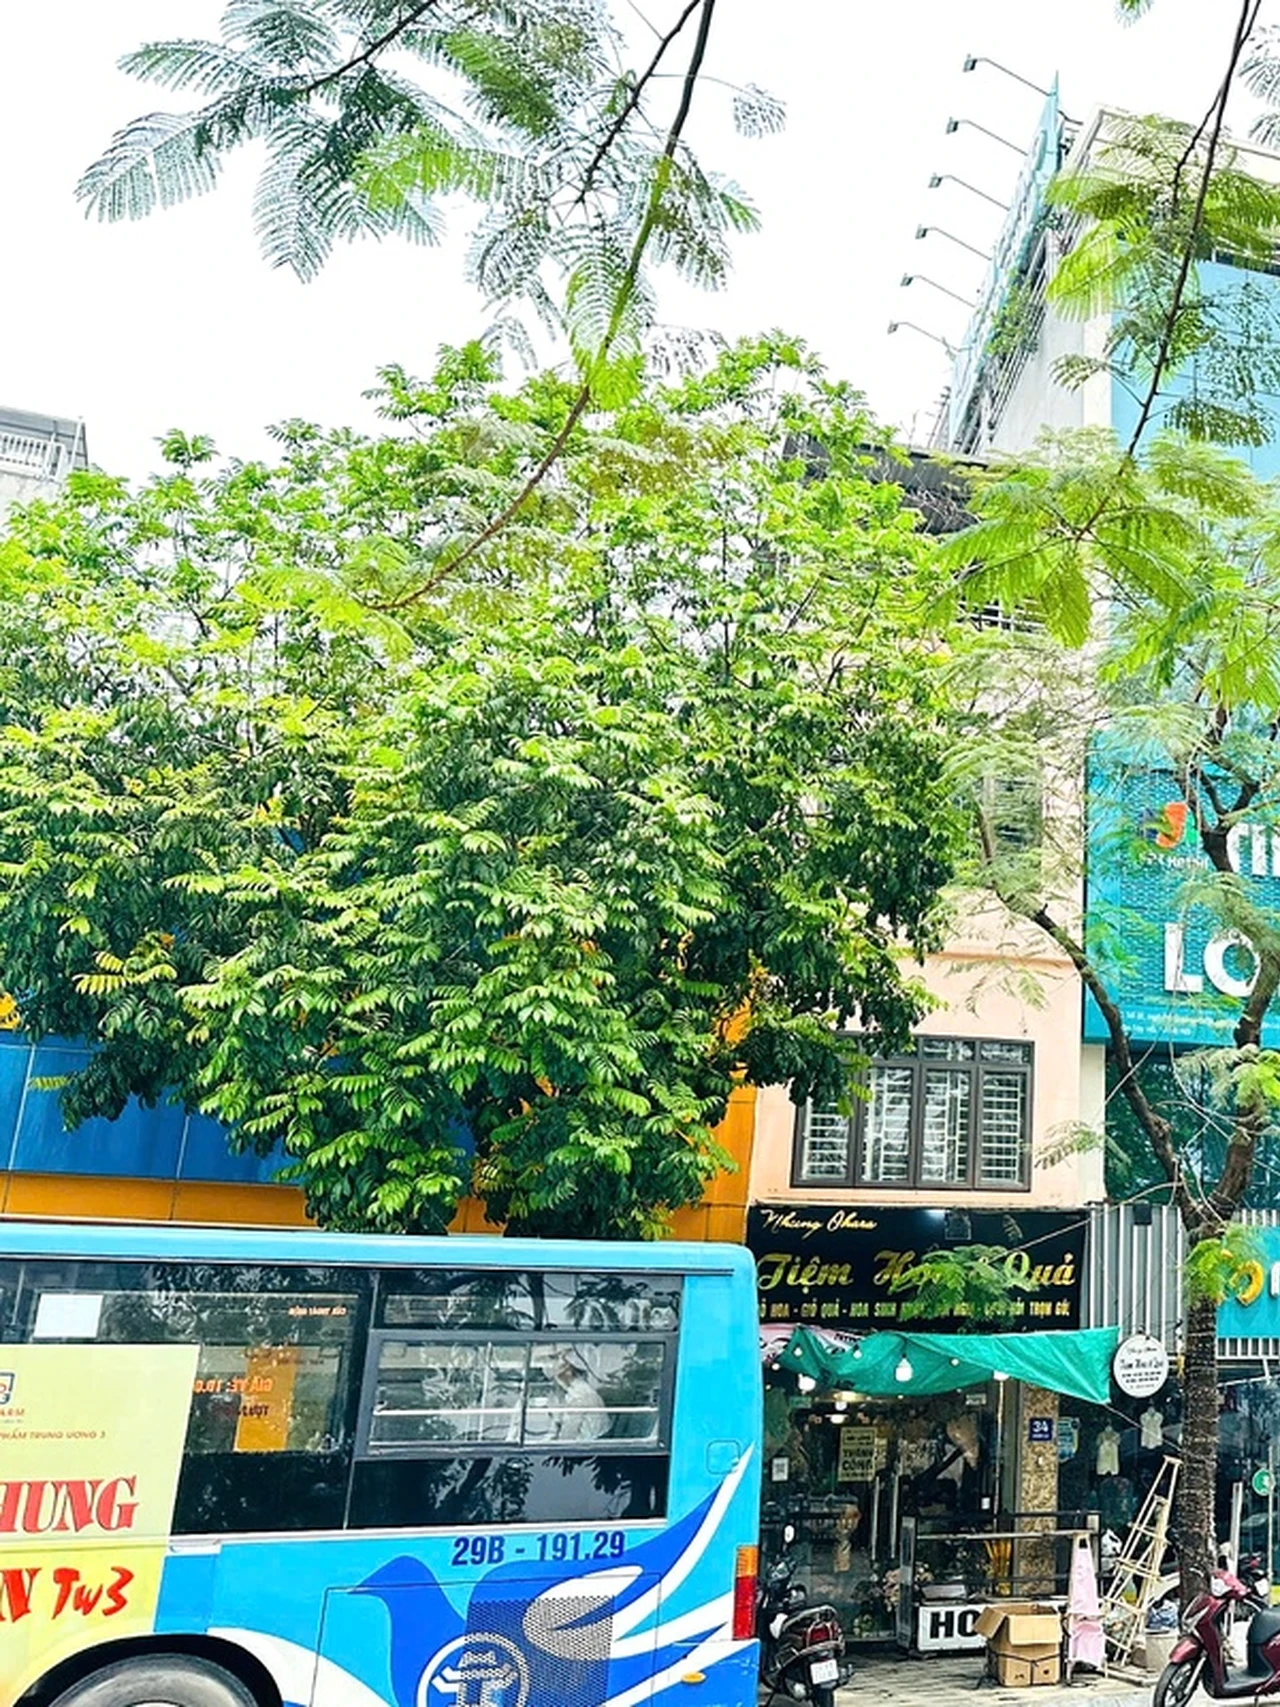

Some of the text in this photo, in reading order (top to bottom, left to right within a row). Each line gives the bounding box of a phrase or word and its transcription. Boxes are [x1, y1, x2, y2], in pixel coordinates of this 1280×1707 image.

[757, 1252, 854, 1294] Tiệm
[1032, 1420, 1049, 1433] 34
[452, 1535, 506, 1566] 29B
[536, 1531, 626, 1562] 191.29
